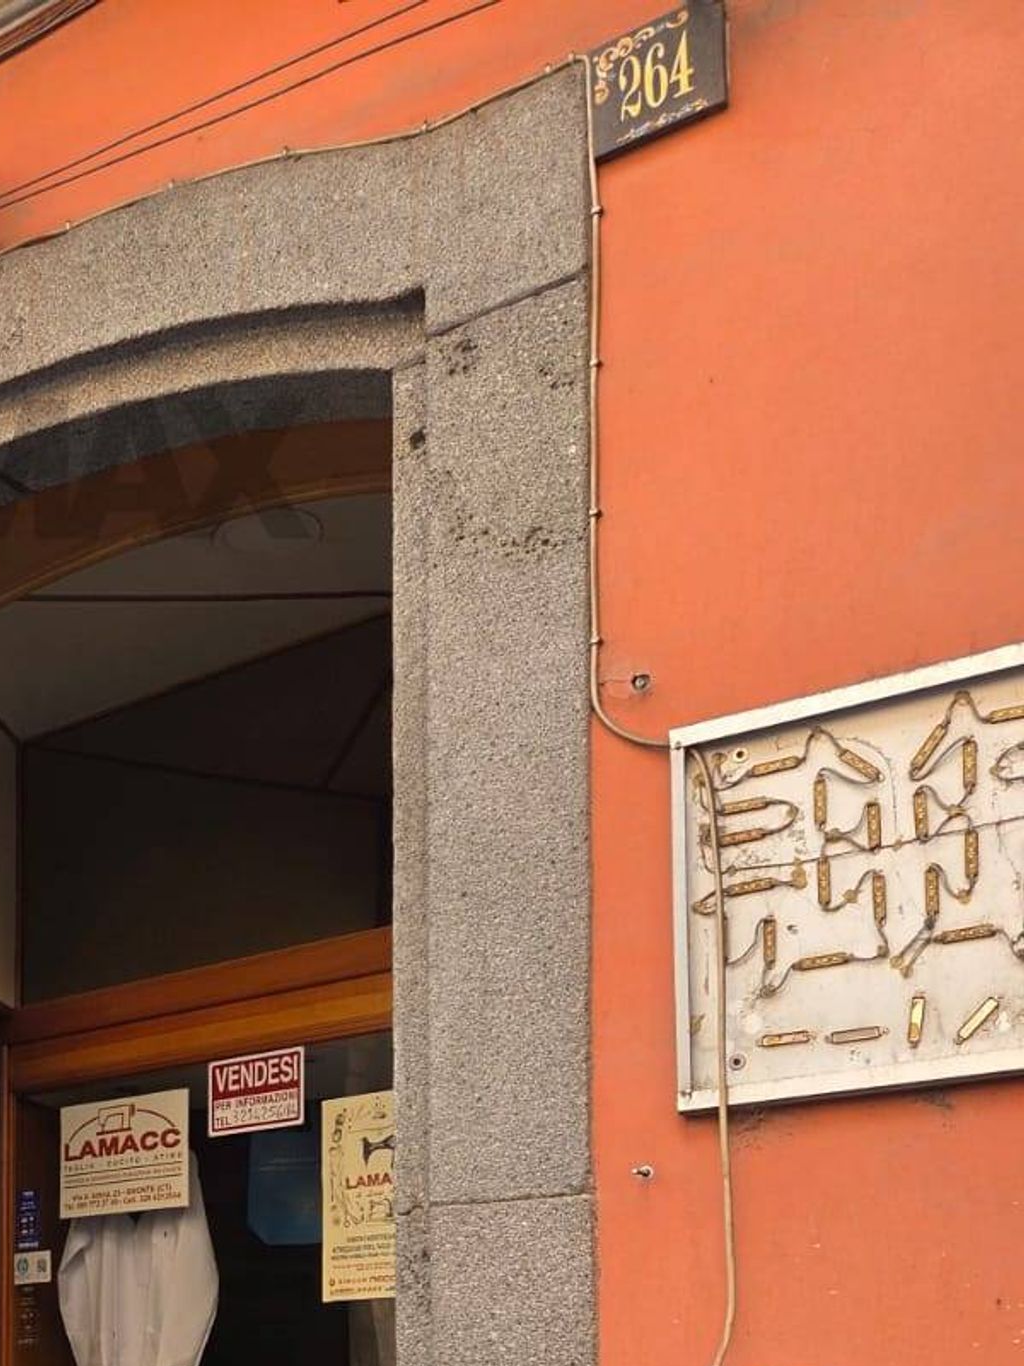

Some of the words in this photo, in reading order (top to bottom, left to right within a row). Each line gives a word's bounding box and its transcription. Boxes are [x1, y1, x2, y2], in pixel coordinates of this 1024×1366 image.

[618, 30, 695, 123] 264
[215, 1054, 298, 1093] VENDESI
[64, 1128, 181, 1161] LAMACC
[345, 1172, 394, 1190] LAMA
